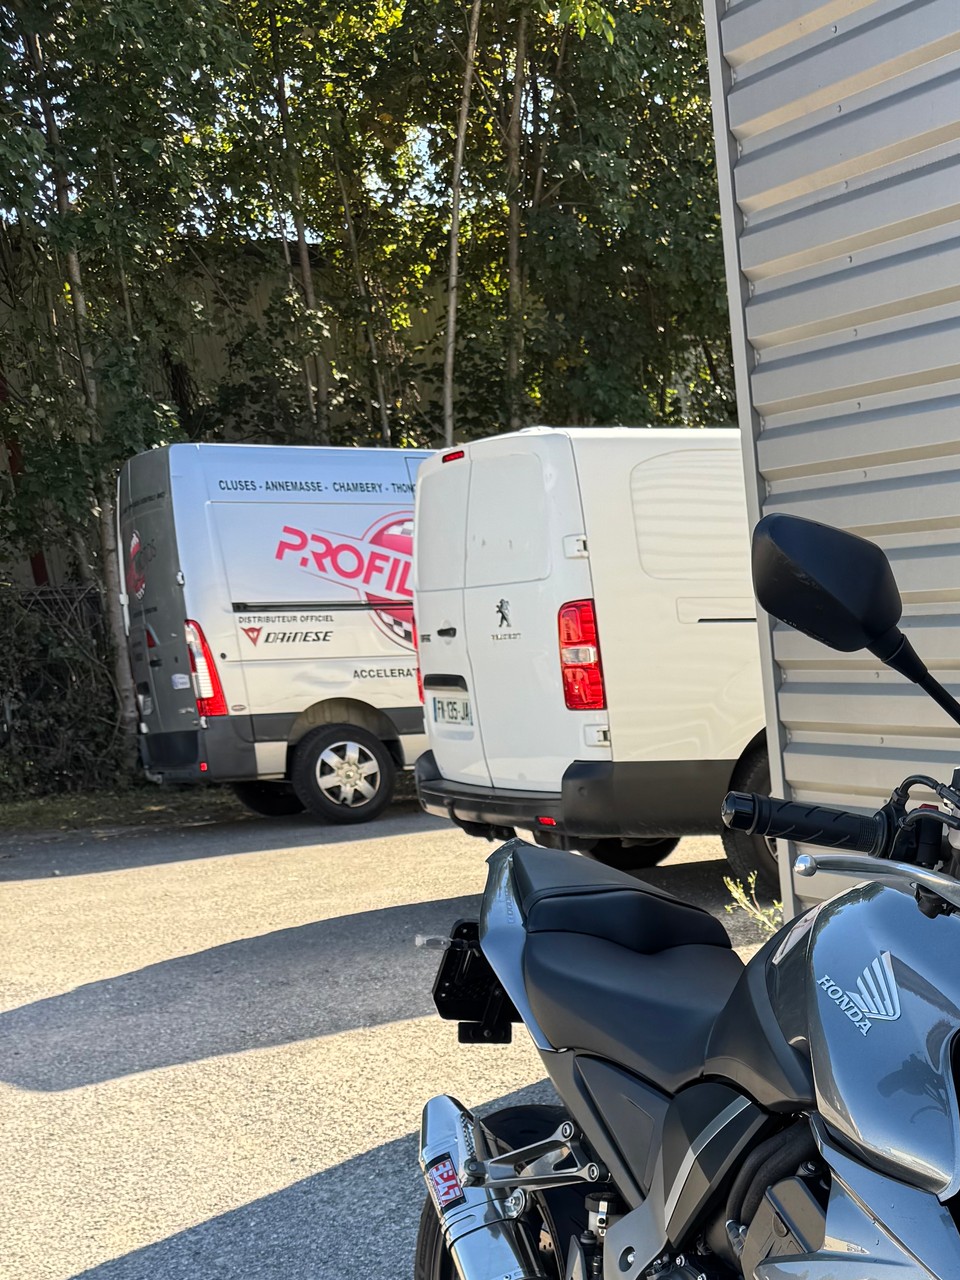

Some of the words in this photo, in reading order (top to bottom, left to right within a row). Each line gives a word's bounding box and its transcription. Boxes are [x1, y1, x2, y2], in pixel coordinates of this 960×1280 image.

[218, 480, 257, 492] CLUSES
[264, 481, 323, 493] ANNEMASSE
[333, 482, 383, 494] CHAMBERY
[238, 615, 298, 624] DISTRIBUTEUR
[299, 614, 335, 623] OFFICIEL
[816, 974, 872, 1037] HONDA
